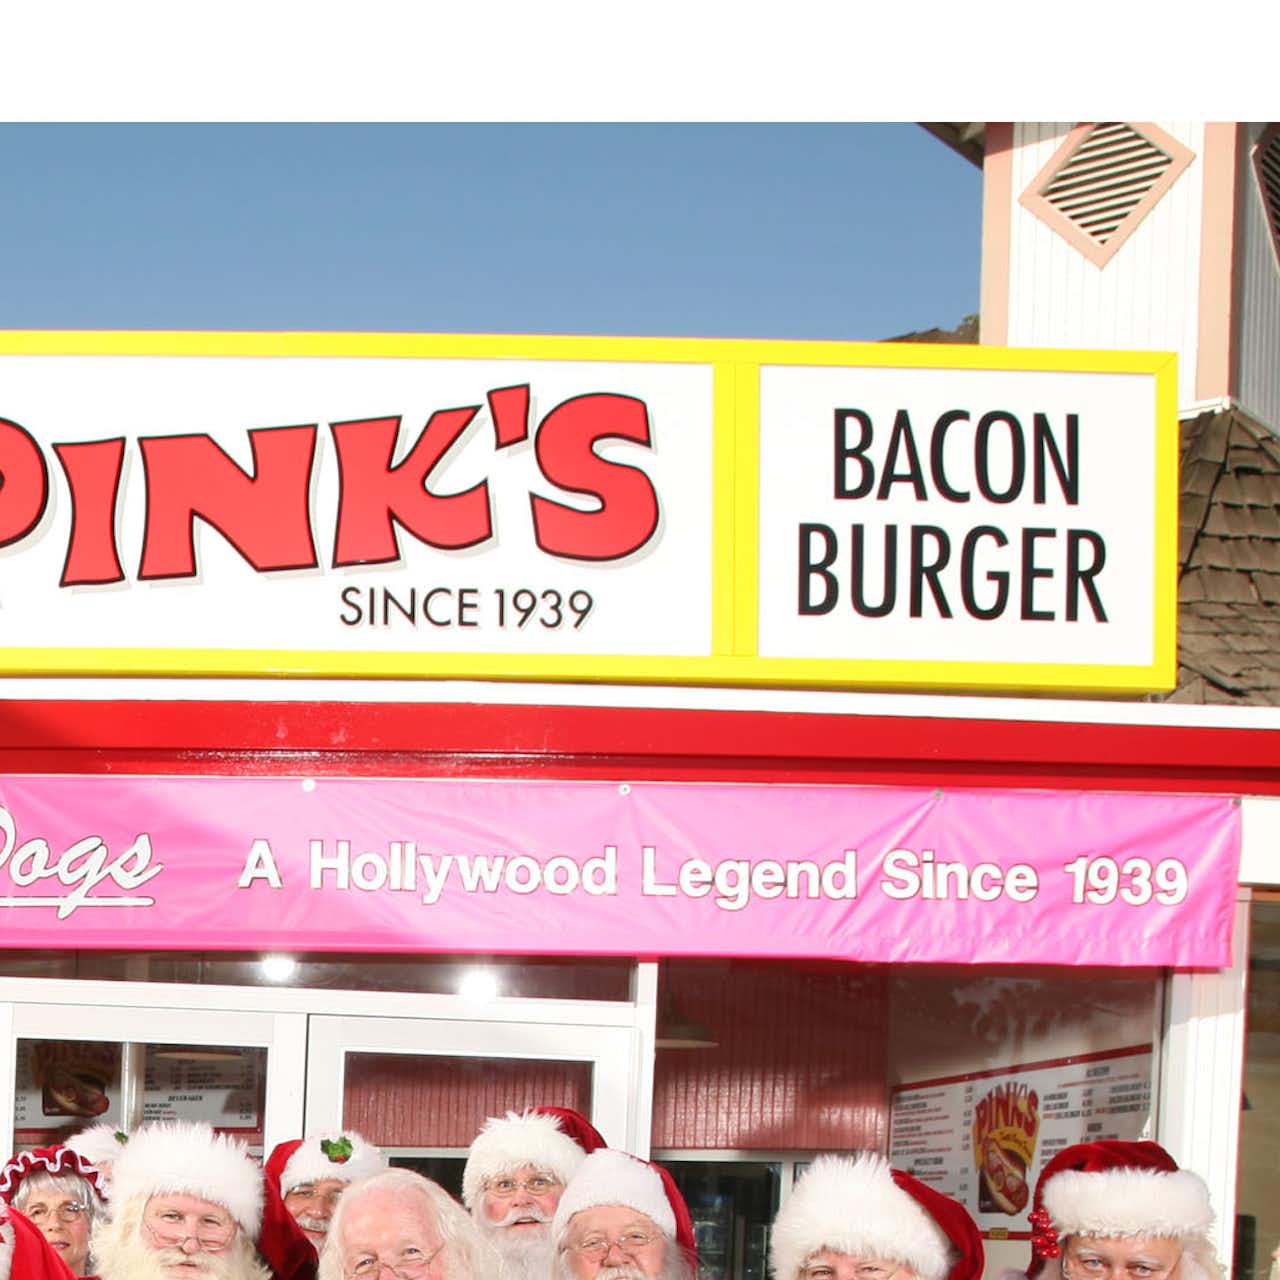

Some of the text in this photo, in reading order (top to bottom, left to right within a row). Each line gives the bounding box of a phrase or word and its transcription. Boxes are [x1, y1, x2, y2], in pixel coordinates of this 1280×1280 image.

[833, 408, 1080, 505] BACON
[340, 587, 594, 629] SINCE 1939
[797, 523, 1109, 623] BURGER
[237, 839, 1190, 912] A Hollywood Legend Since 1939
